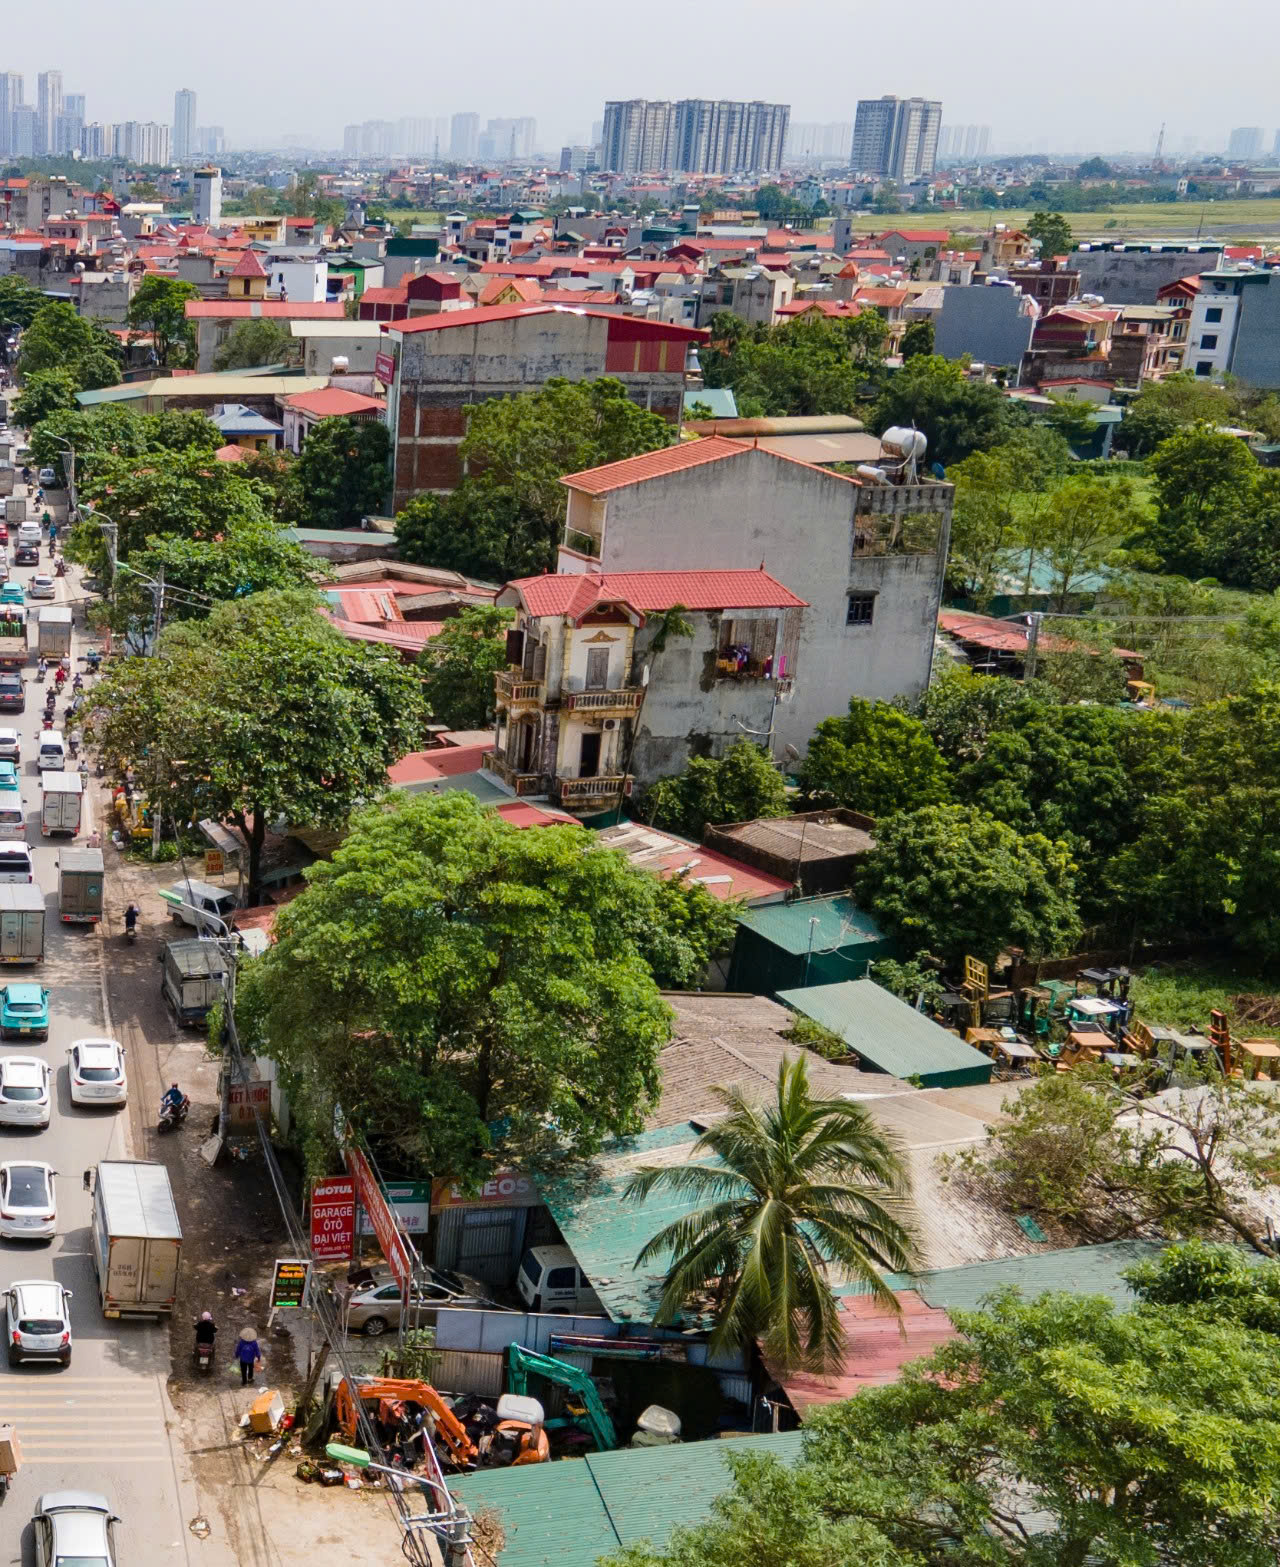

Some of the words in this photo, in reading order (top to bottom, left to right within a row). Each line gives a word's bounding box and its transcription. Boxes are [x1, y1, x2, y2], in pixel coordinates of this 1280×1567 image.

[314, 1185, 353, 1196] MOTUL
[314, 1206, 353, 1218] GARAGE
[332, 1232, 351, 1245] VIỆT
